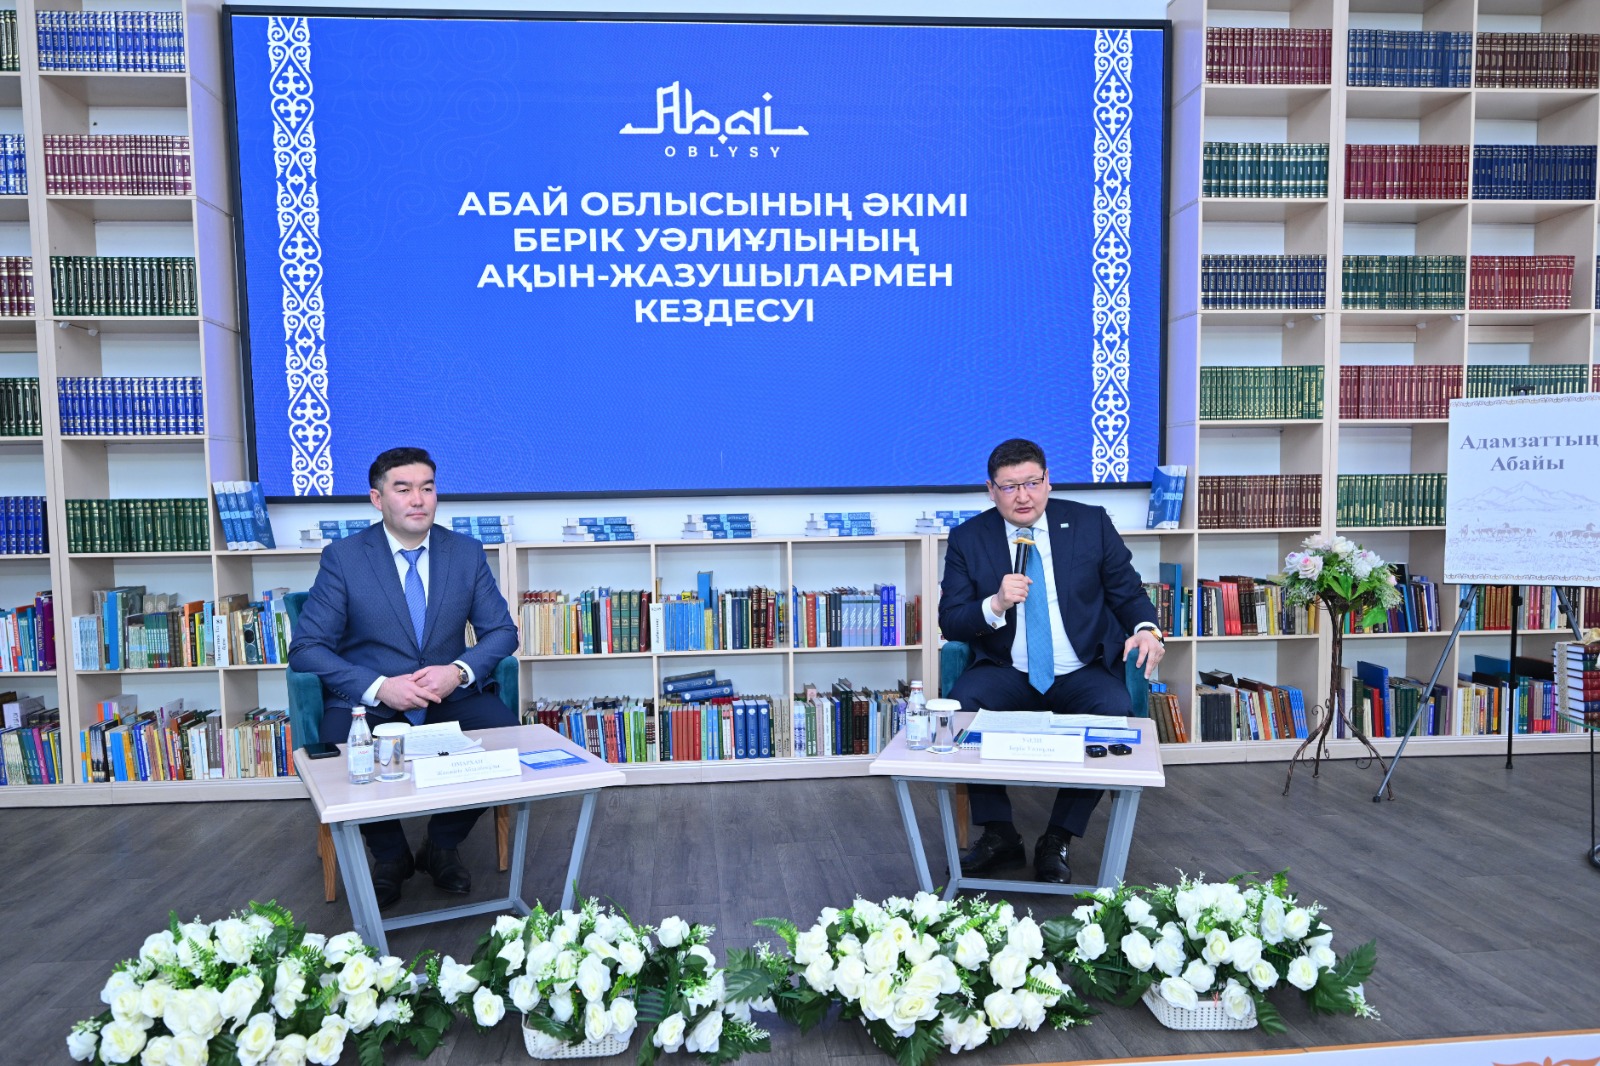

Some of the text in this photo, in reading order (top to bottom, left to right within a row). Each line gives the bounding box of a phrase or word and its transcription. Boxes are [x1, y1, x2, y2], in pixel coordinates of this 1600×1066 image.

[664, 145, 780, 158] OBLYSY
[458, 185, 967, 221] АБАЙ ОБЛЫСЫНЫҢ ӘКІМІ
[513, 227, 920, 256] БЕРІК УӘЛИҰЛЫНЫҢ
[477, 263, 953, 293] АҚЫН-ЖАЗУШЫЛАРМЕН
[635, 298, 814, 327] КЕЗДЕСУІ
[1460, 434, 1600, 451] Адамзаттың
[1490, 455, 1565, 472] Абайы
